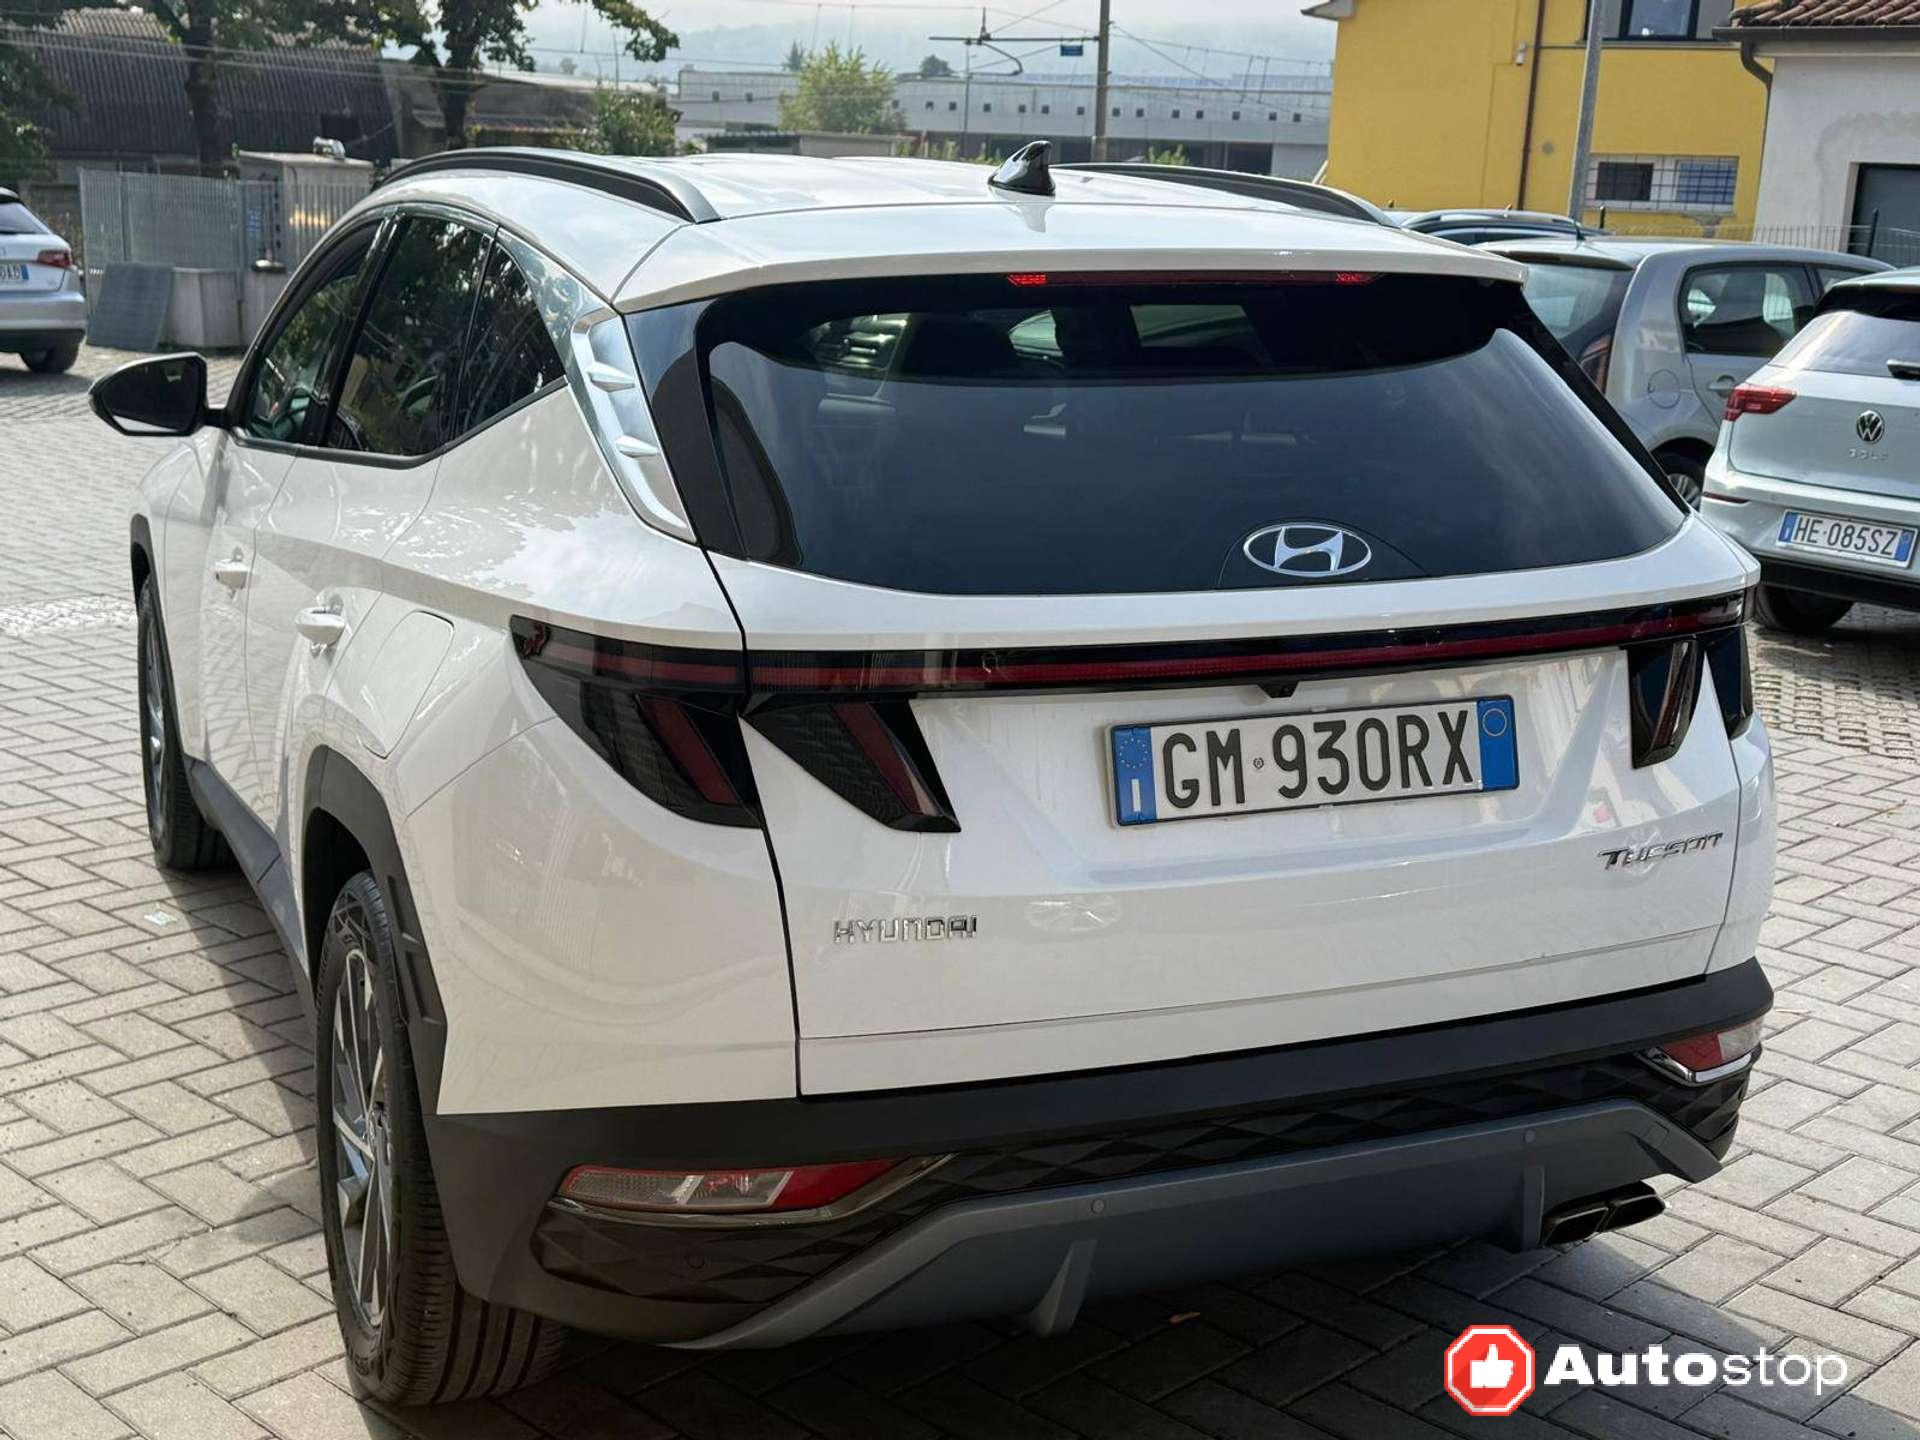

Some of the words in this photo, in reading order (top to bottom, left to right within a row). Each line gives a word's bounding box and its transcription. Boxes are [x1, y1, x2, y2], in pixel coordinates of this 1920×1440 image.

[1794, 516, 1823, 543] HE
[1827, 523, 1898, 556] 085SZ
[1162, 728, 1245, 809] GM
[1272, 710, 1473, 799] 930RX
[834, 915, 977, 943] HYUNDAI
